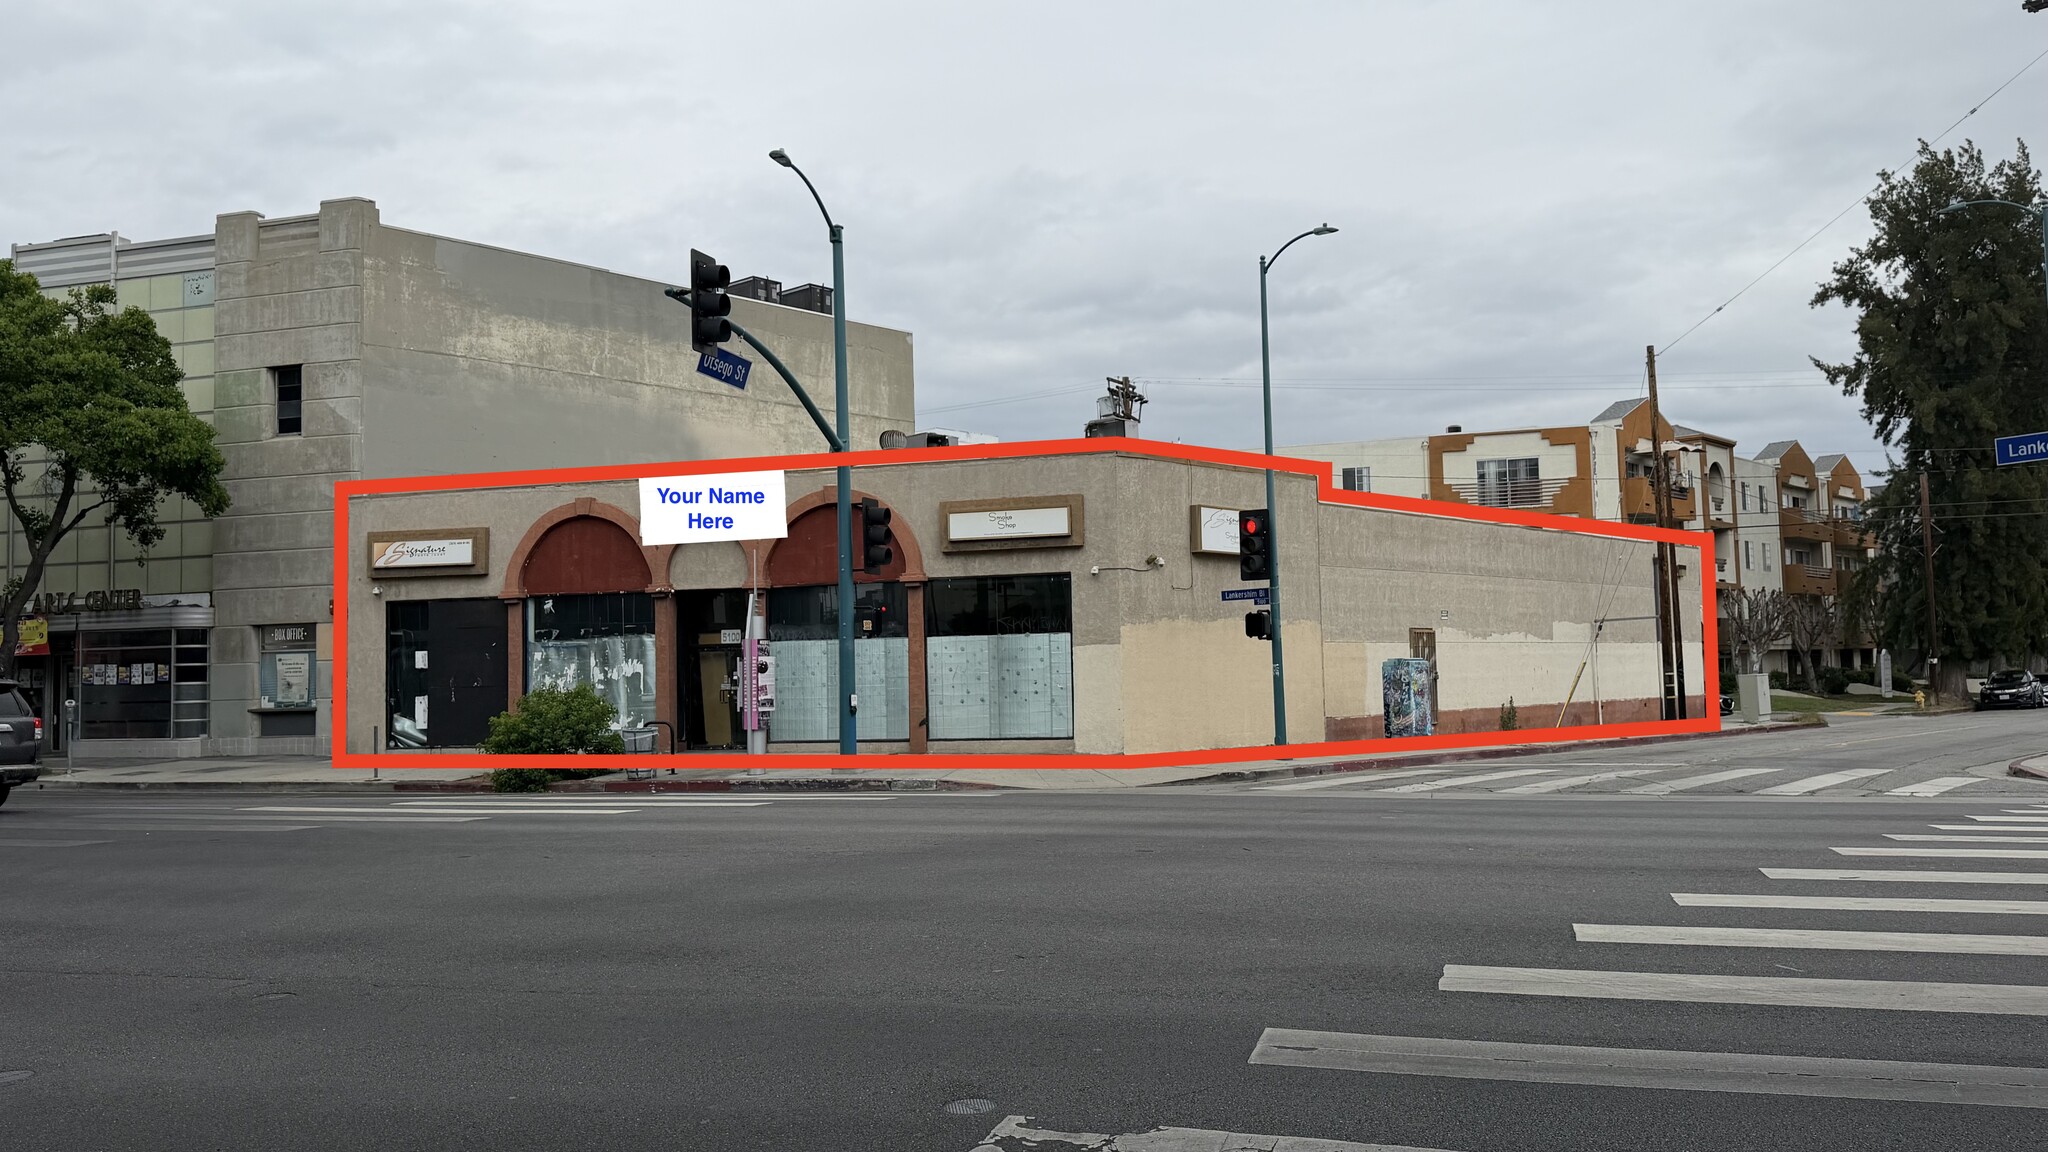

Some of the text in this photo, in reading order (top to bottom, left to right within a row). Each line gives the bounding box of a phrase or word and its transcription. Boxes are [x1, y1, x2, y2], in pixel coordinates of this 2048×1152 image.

[703, 355, 745, 382] Otsego St
[2008, 440, 2048, 457] Lank
[988, 512, 1013, 522] Smoke
[998, 520, 1016, 530] Shop
[384, 542, 446, 565] Signature
[31, 592, 76, 615] ARTS
[85, 589, 143, 612] CENTER
[1225, 590, 1258, 600] Lankershim
[274, 627, 305, 641] BOX OFFICE
[722, 632, 740, 642] 5100
